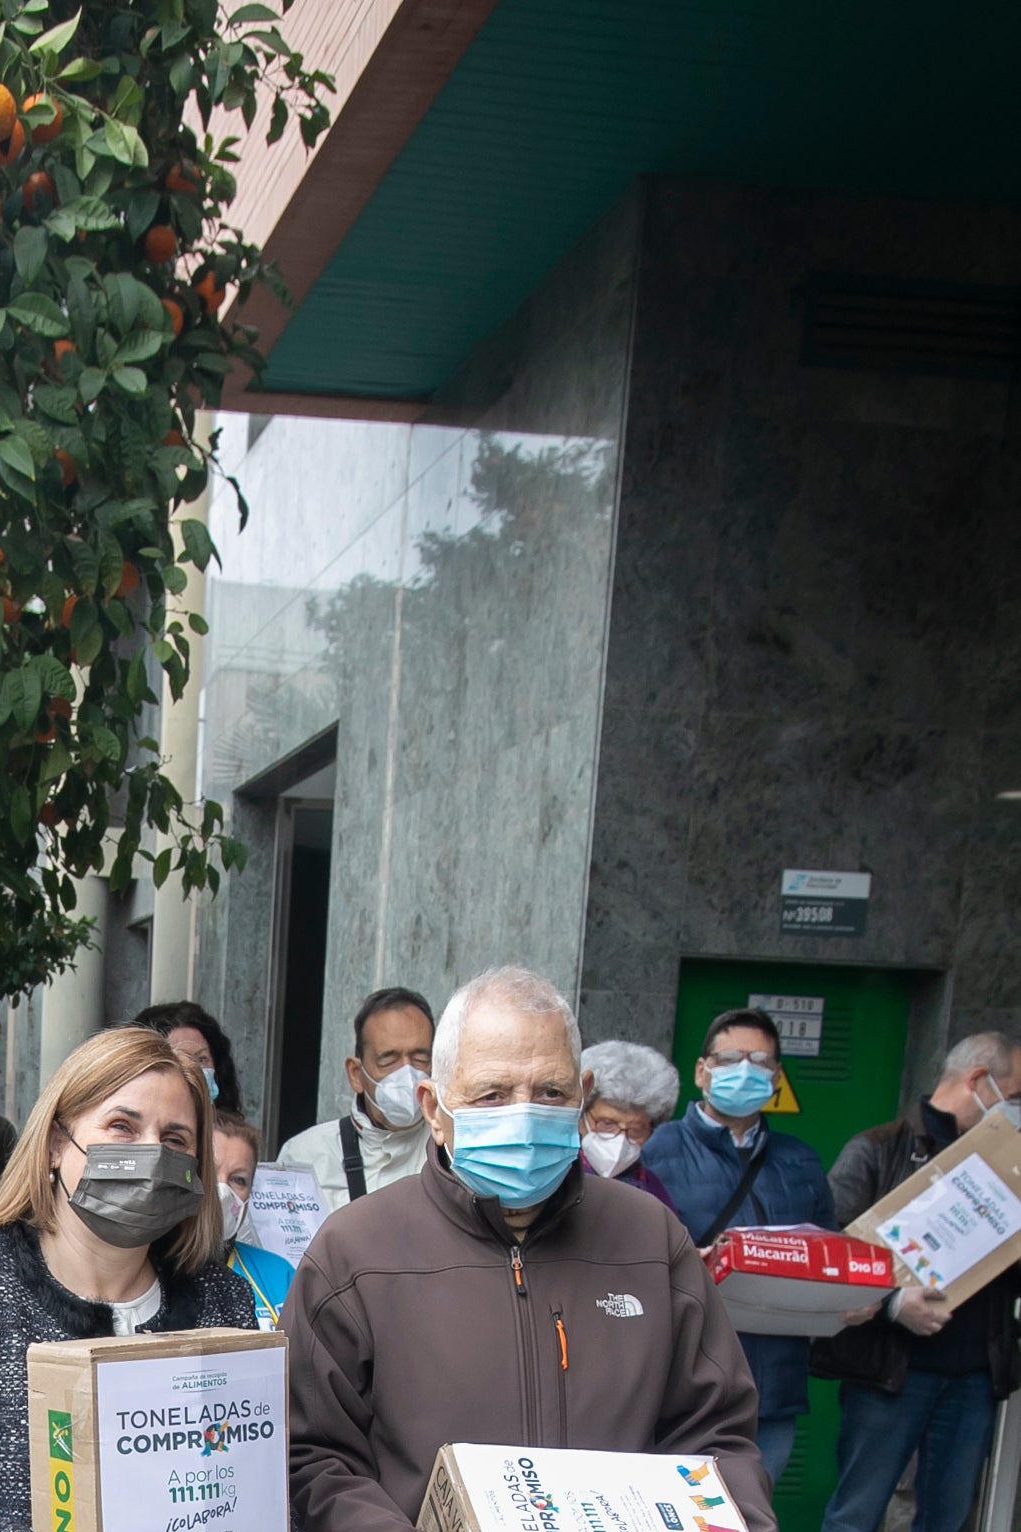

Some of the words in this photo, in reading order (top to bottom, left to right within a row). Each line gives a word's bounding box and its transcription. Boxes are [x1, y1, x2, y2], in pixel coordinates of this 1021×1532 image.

[253, 1201, 320, 1212] COMPROMISO
[742, 1244, 808, 1264] Macarrão
[608, 1292, 624, 1301] THE
[596, 1300, 624, 1310] NORTH
[606, 1308, 626, 1318] FACE
[172, 1374, 198, 1383] Campaña
[182, 1378, 227, 1390] ALIMENTOS
[116, 1400, 251, 1430] TONELADAS
[254, 1402, 271, 1417] de
[116, 1420, 274, 1456] COMPROMISO
[504, 1458, 514, 1473] de
[168, 1469, 181, 1486] A
[185, 1468, 213, 1487] por
[216, 1464, 235, 1480] los
[436, 1465, 454, 1518] CAJA
[662, 1503, 678, 1524] ONCE
